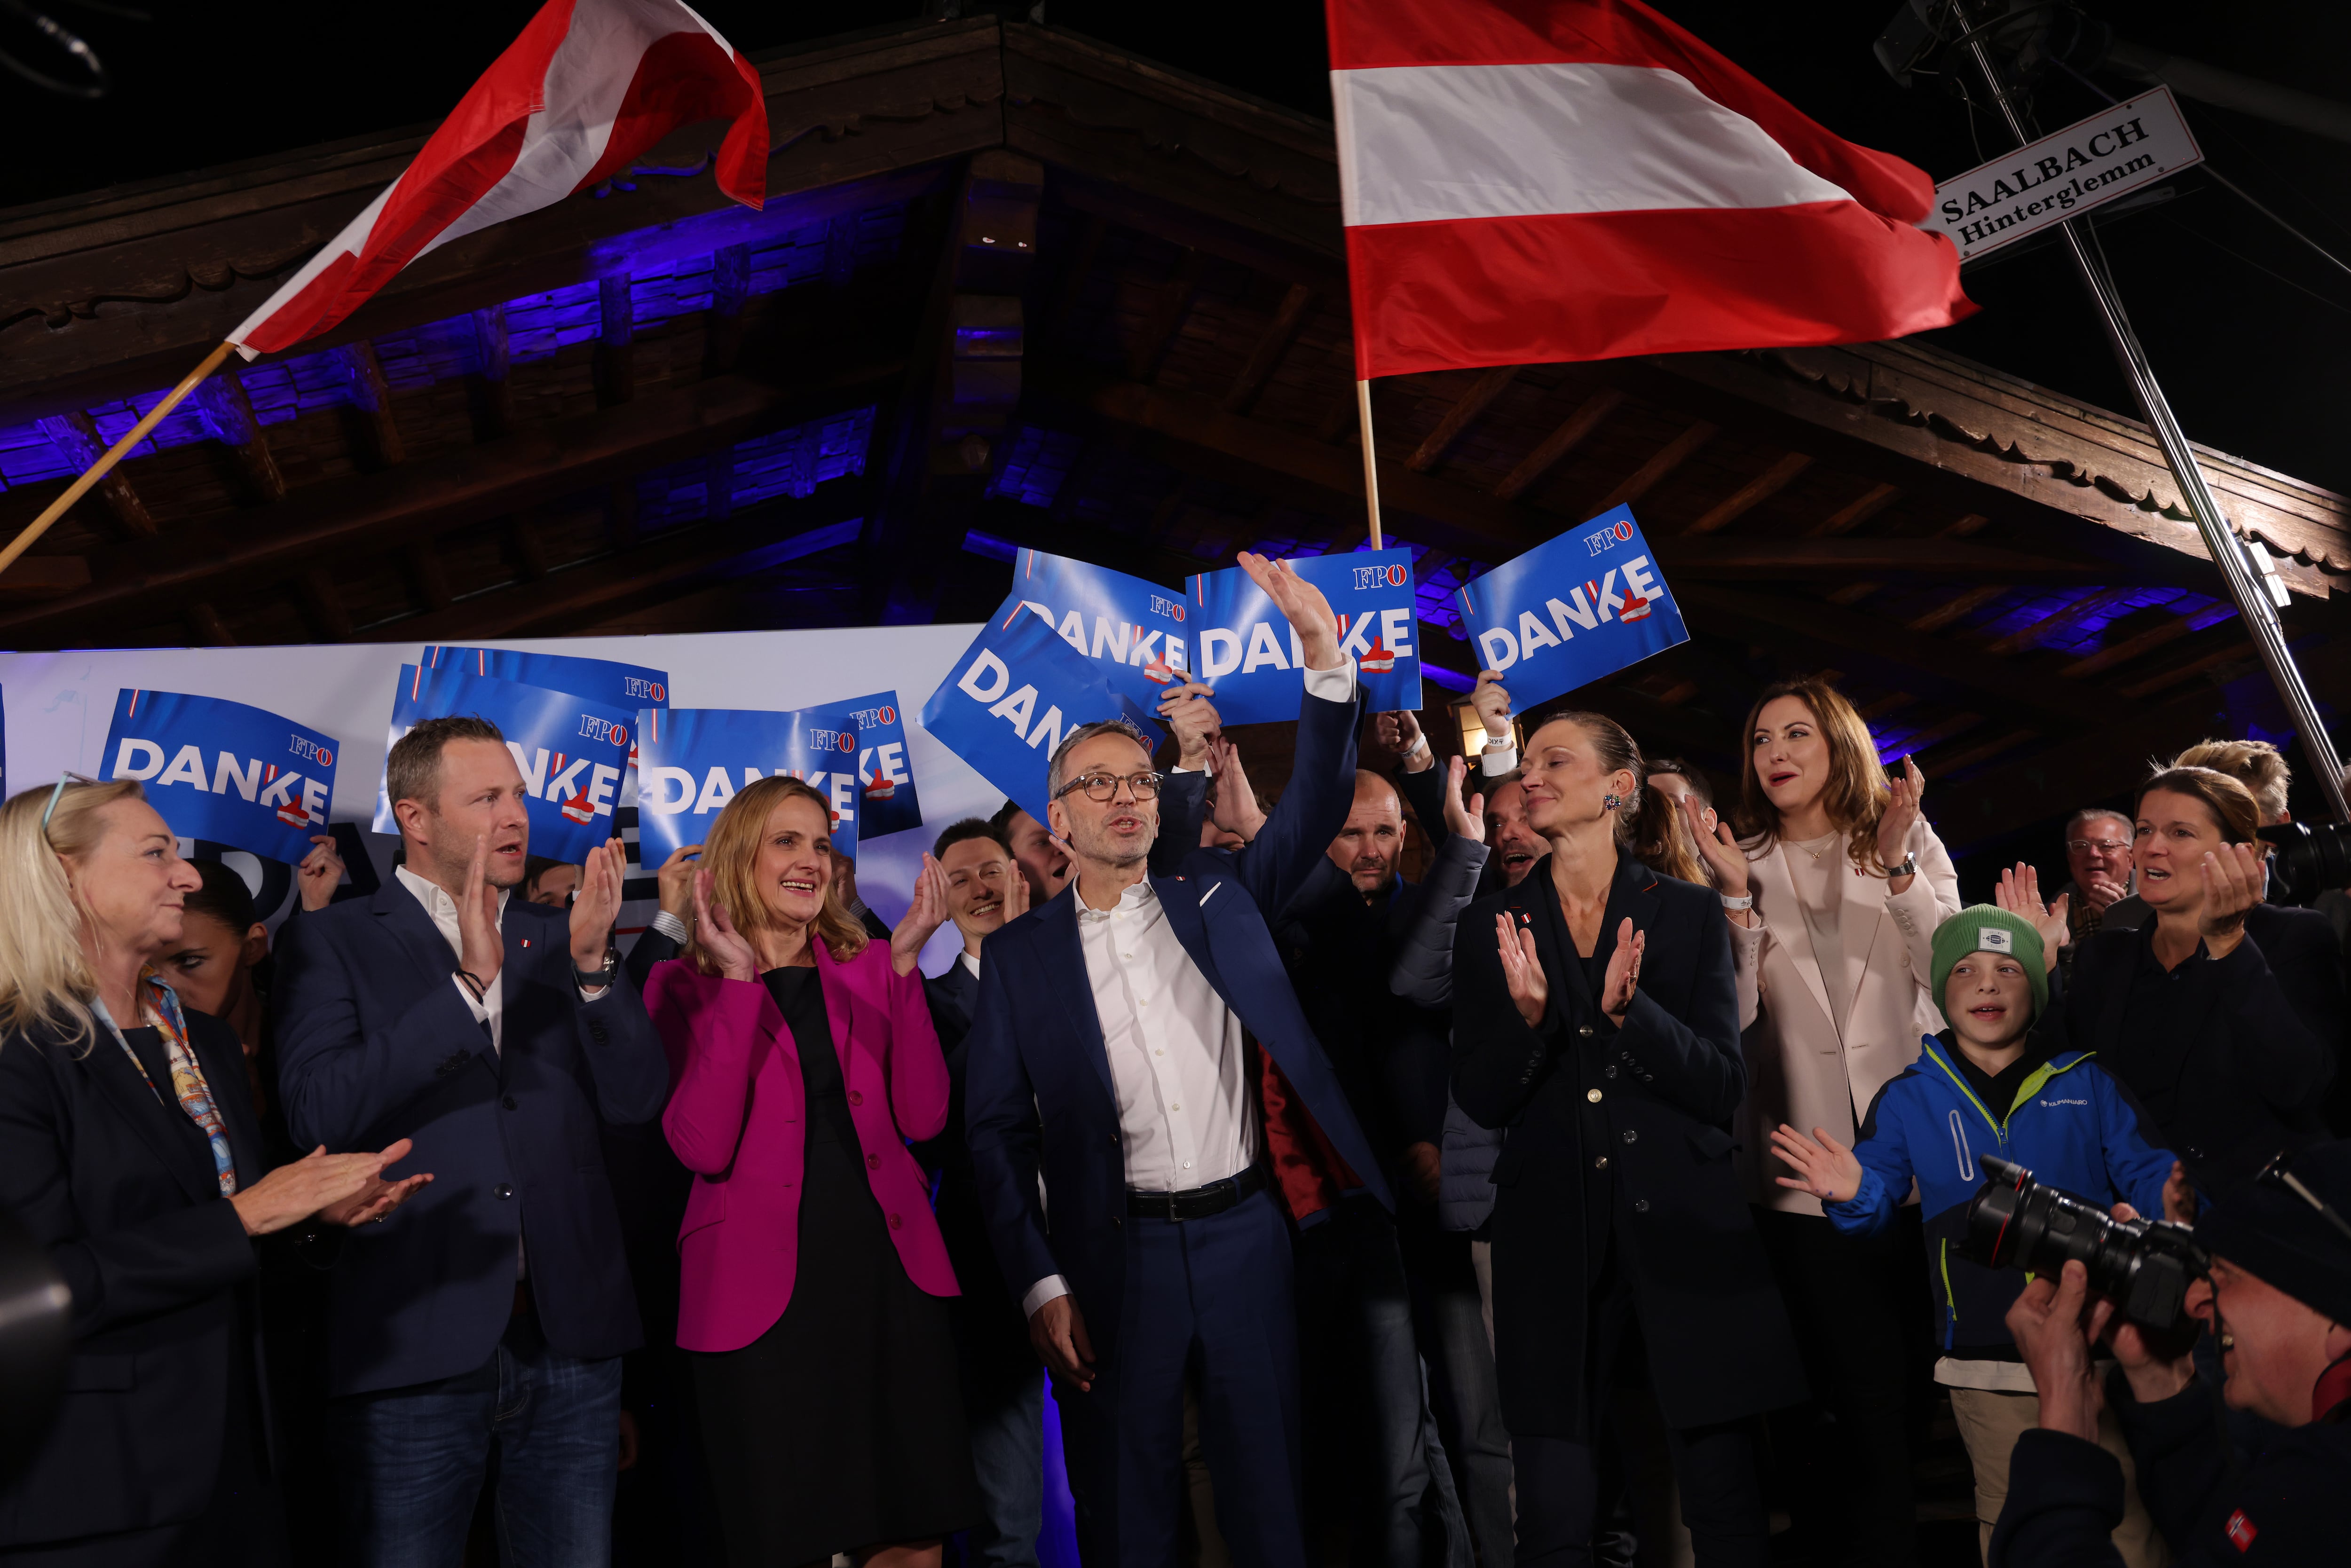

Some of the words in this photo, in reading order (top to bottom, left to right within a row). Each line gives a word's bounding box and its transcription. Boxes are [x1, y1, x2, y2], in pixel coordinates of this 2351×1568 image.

[1941, 118, 2149, 224] SAALBACH
[1957, 153, 2155, 245] Hinterglemm
[1478, 555, 1664, 672] DANKE
[112, 738, 328, 825] DANKE
